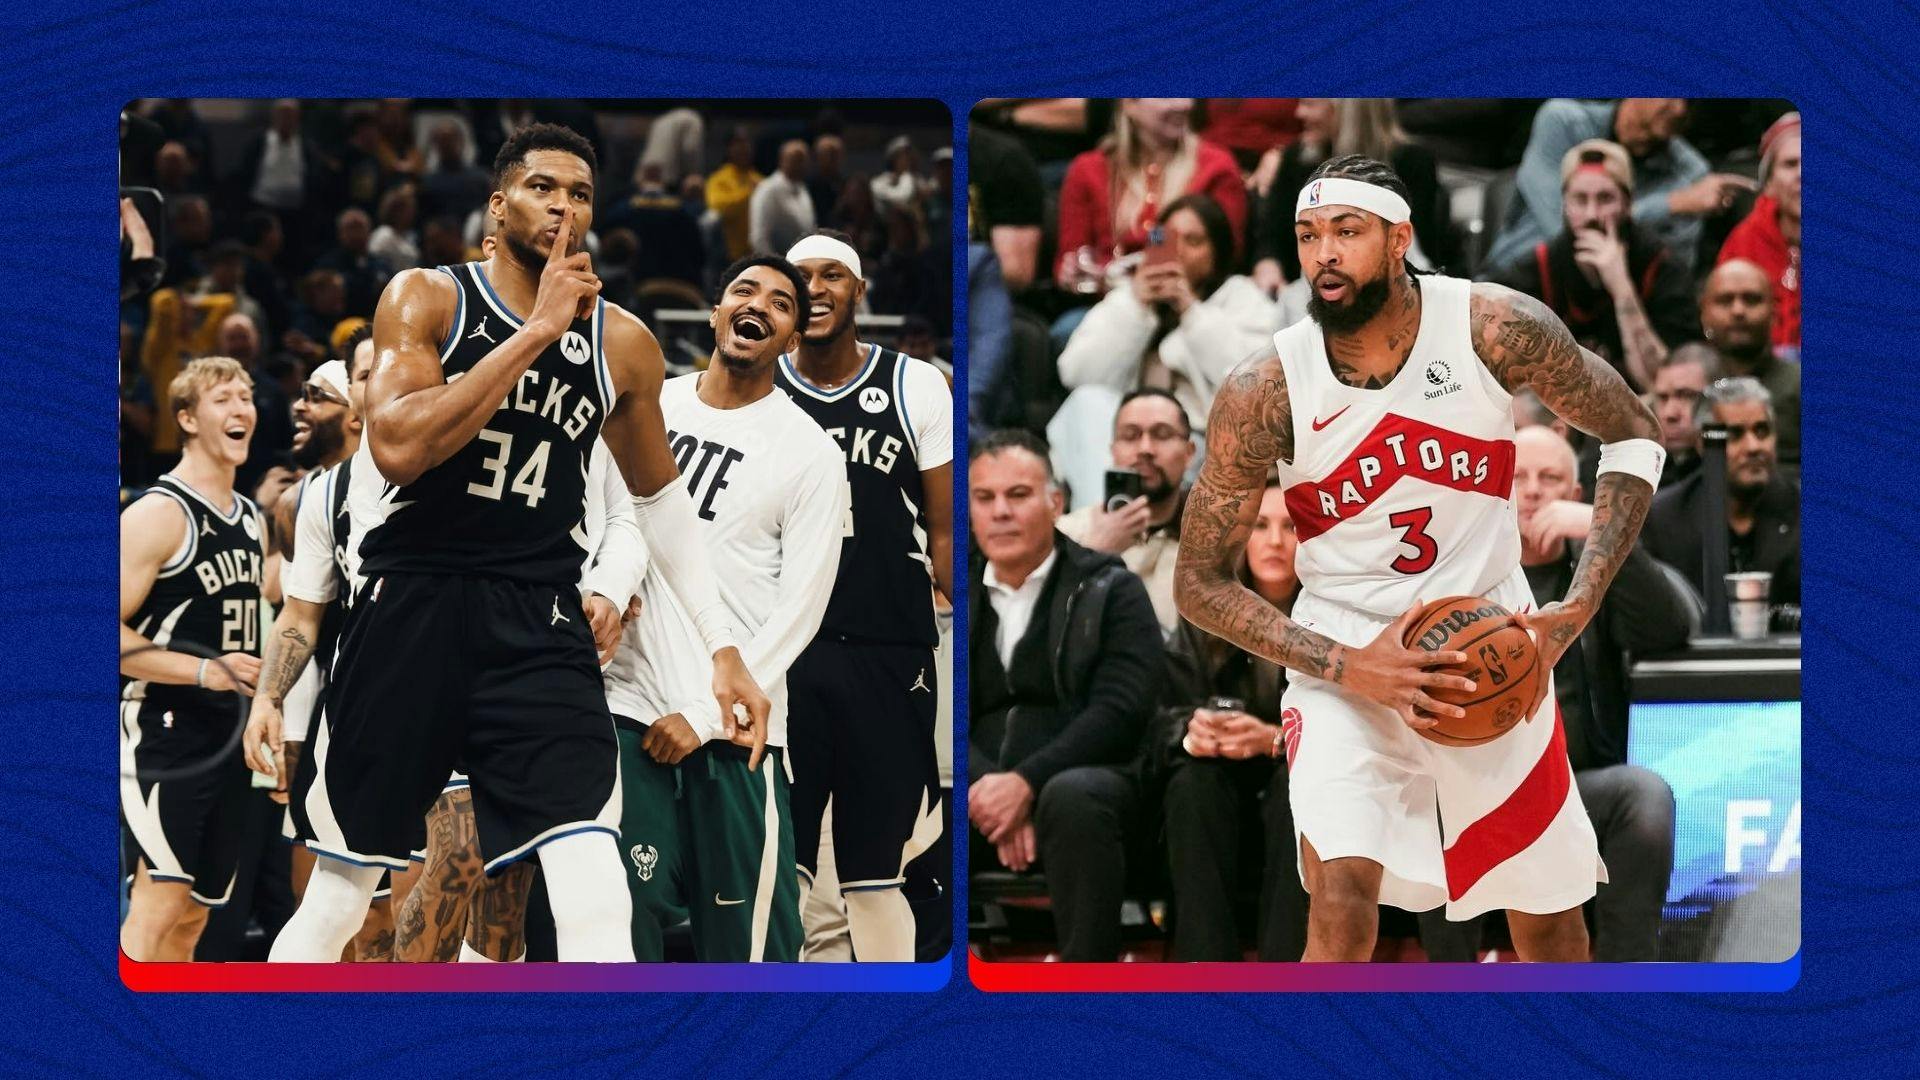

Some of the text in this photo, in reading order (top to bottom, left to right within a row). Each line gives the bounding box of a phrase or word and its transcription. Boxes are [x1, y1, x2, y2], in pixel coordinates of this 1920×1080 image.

[1424, 382, 1463, 400] Sun Life
[467, 428, 552, 508] 34
[1317, 433, 1489, 519] RAPTORS
[1388, 506, 1439, 575] 3
[194, 548, 264, 596] BUCK
[221, 599, 257, 651] 20
[1416, 605, 1509, 652] Wilson
